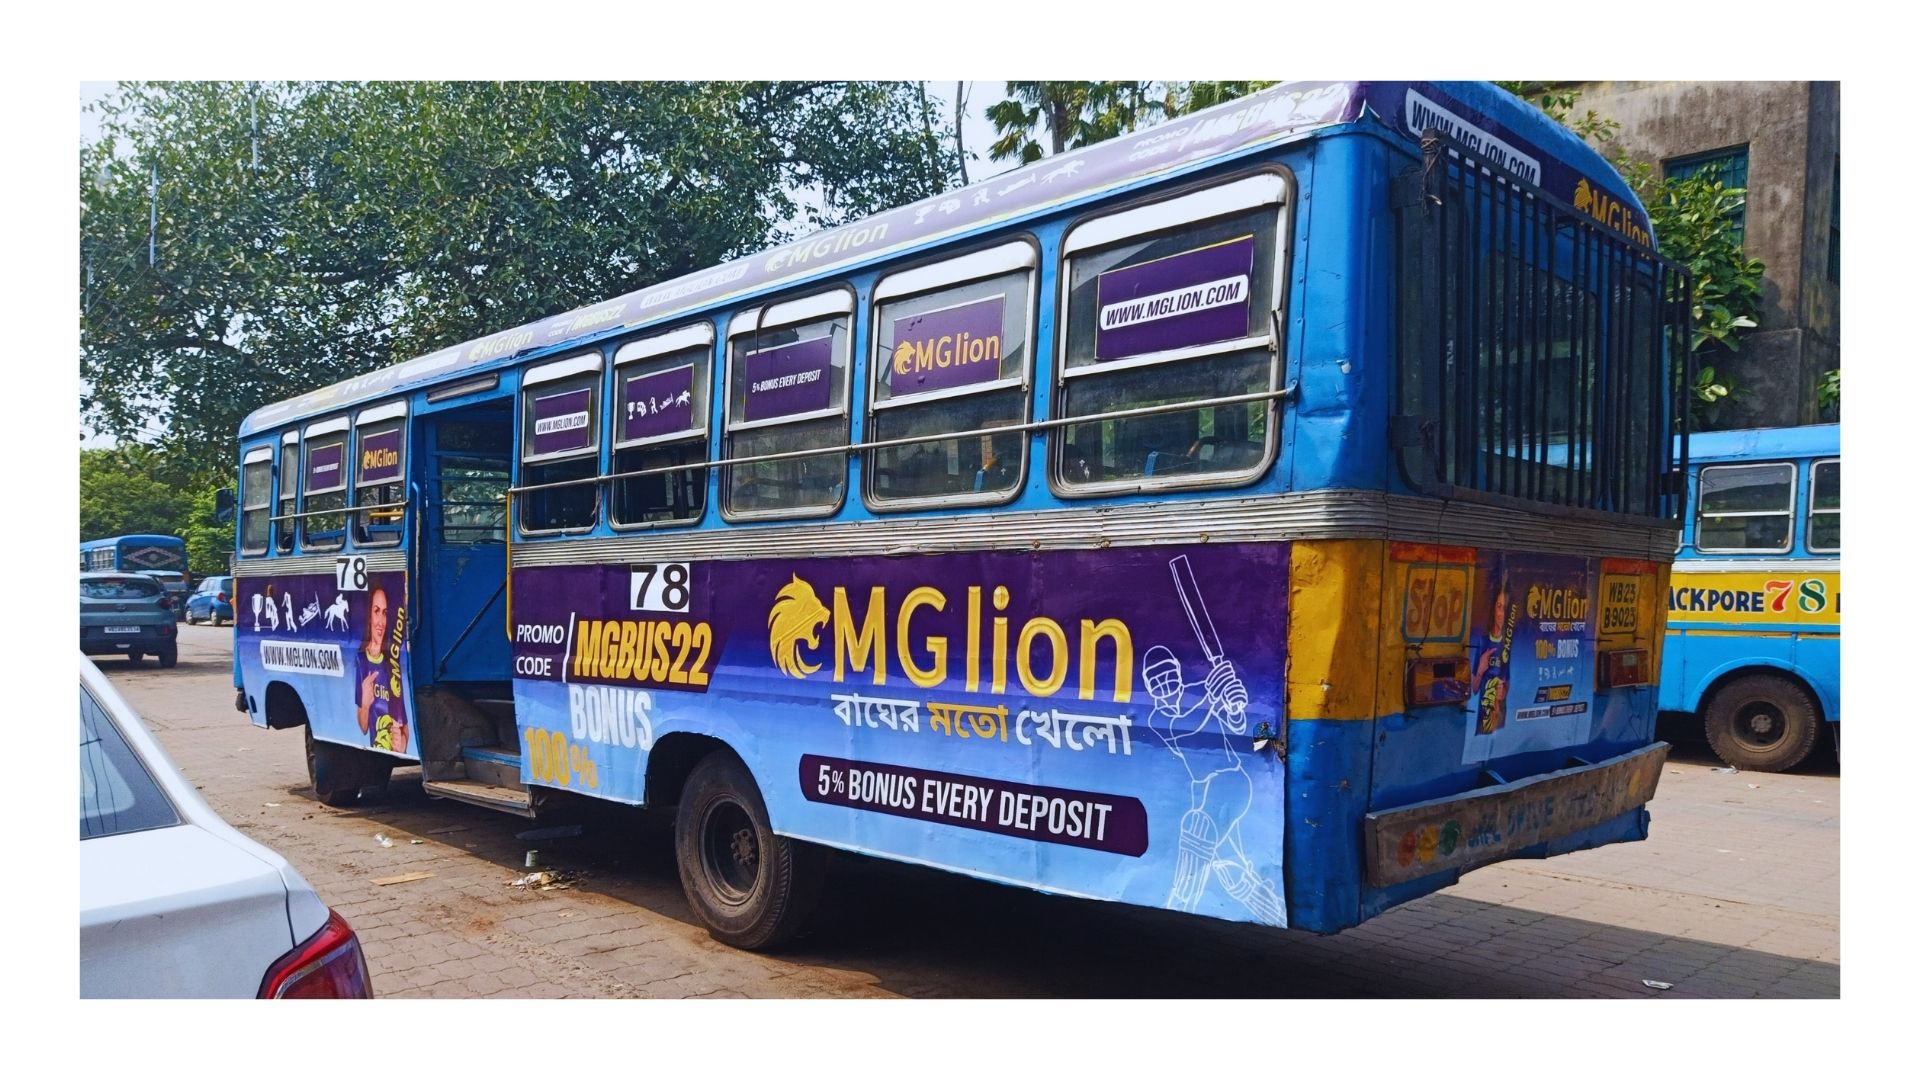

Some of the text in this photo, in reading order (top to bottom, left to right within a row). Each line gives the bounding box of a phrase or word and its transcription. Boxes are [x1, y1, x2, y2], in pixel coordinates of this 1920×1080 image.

[787, 223, 889, 267] MGlion
[1105, 281, 1241, 327] WWW.MGLION.COM
[480, 331, 534, 359] MGlion
[915, 333, 999, 374] MGlion
[760, 378, 779, 391] BONUS
[779, 374, 797, 388] EVERY
[797, 369, 822, 384] DEPOSIT
[537, 415, 586, 432] WWW.MGLION.COM
[370, 448, 398, 469] MGlion
[336, 557, 368, 589] 78
[631, 564, 689, 611] 78
[516, 624, 565, 644] PROMO
[574, 620, 712, 685] MGBUS22
[833, 585, 1134, 702] MGlion
[263, 645, 340, 671] WWW.MGLION.COM
[516, 656, 552, 676] CODE
[569, 684, 653, 751] BONUS
[830, 693, 1132, 755] বাঘের মতো খেলো
[848, 769, 915, 810] BONUS
[921, 780, 994, 822] EVERY
[999, 792, 1113, 841] DEPOSIT
